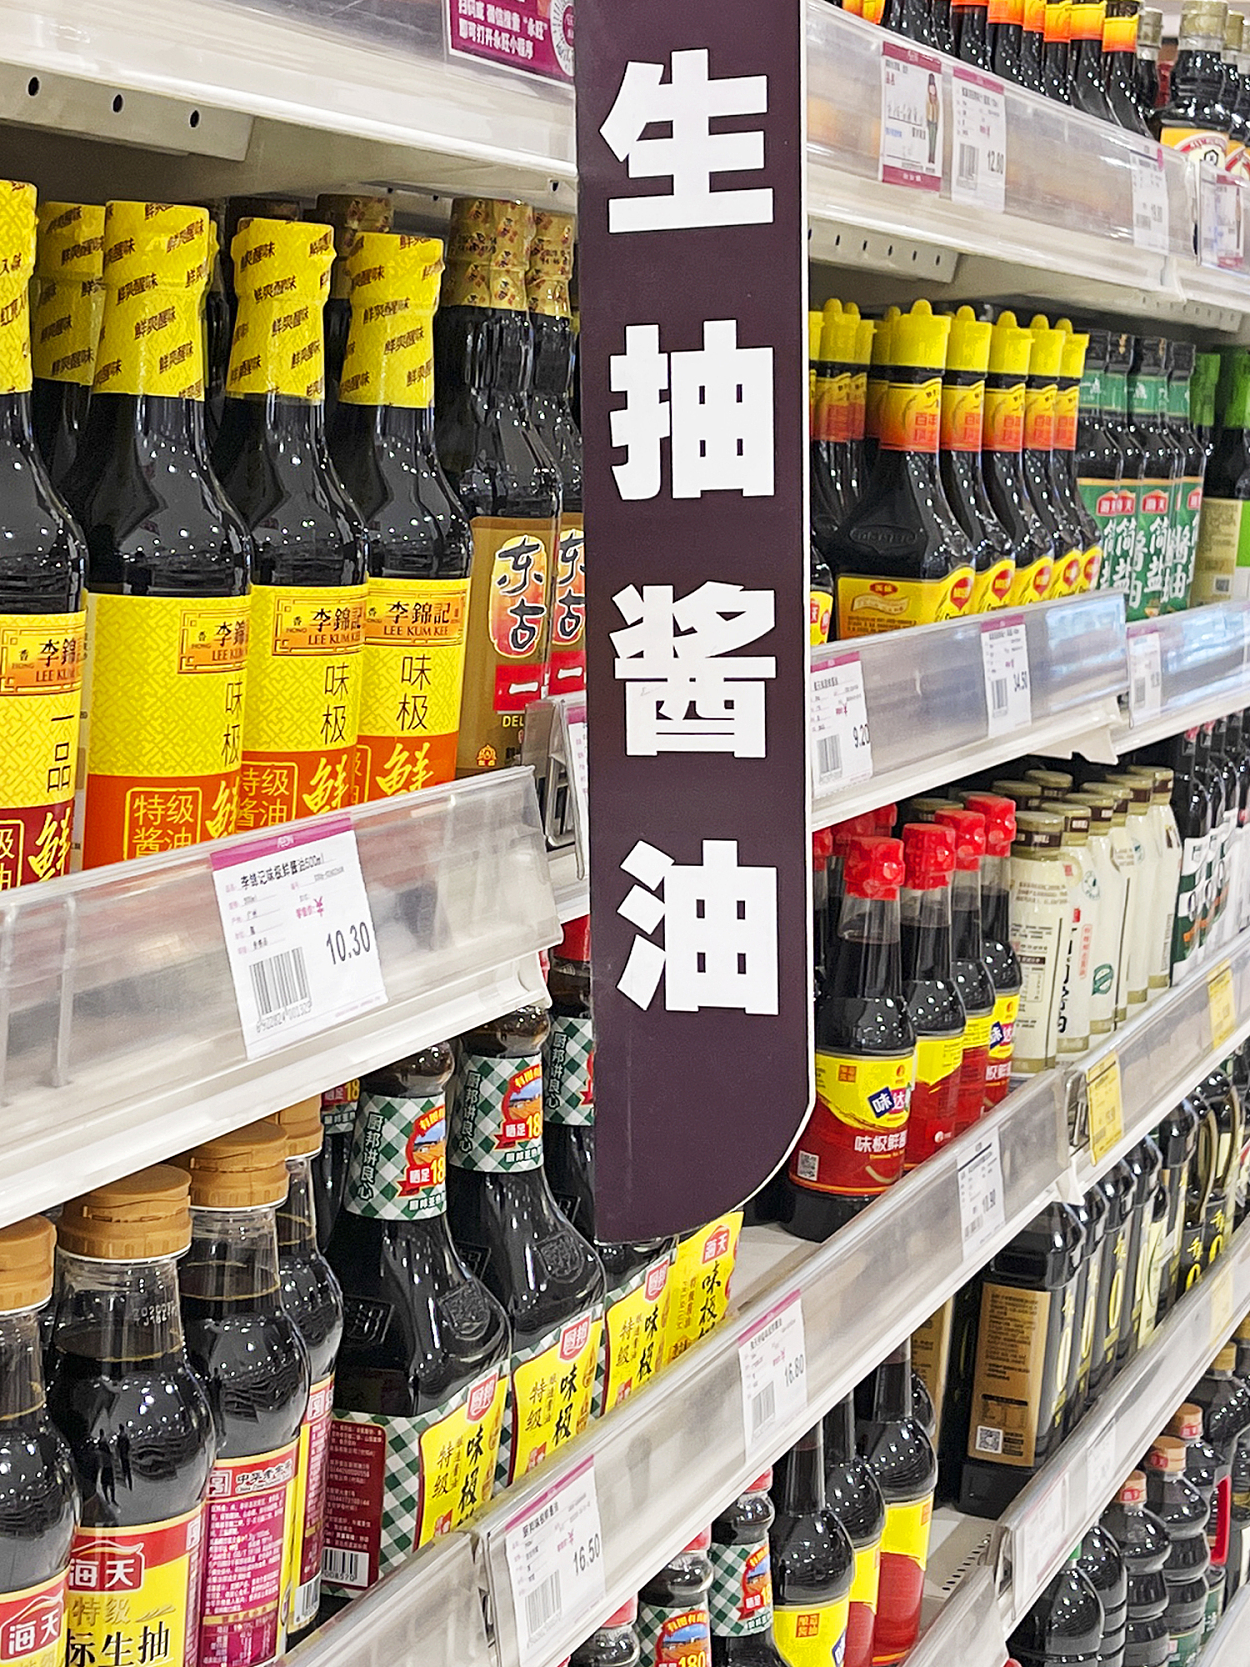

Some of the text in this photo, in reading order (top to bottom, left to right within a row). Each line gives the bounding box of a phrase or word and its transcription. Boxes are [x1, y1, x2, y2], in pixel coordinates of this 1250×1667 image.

[599, 47, 780, 1016] 生抽酱油
[497, 535, 546, 652] 东古
[385, 600, 450, 625] 李錦記
[214, 621, 246, 648] 李錦
[308, 634, 326, 646] LEE
[329, 632, 349, 644] KUM
[383, 625, 403, 636] LEE
[406, 625, 431, 636] KUM
[39, 637, 86, 668] 李錦
[212, 648, 229, 661] LEE
[231, 645, 245, 659] KU
[36, 669, 54, 683] LEE
[319, 663, 350, 745] 味极
[396, 654, 433, 732] 味极
[46, 713, 75, 792] 一品
[133, 794, 194, 826] 特级
[131, 828, 192, 857] 酱油
[326, 921, 372, 965] 10.30
[458, 1070, 481, 1153] 厨邦讲良心
[357, 1112, 385, 1200] 厨邦讲良心
[572, 1532, 601, 1577] 16.50
[68, 1557, 135, 1589] 海天
[72, 1596, 132, 1627] 特级
[8, 1607, 61, 1656] 海天
